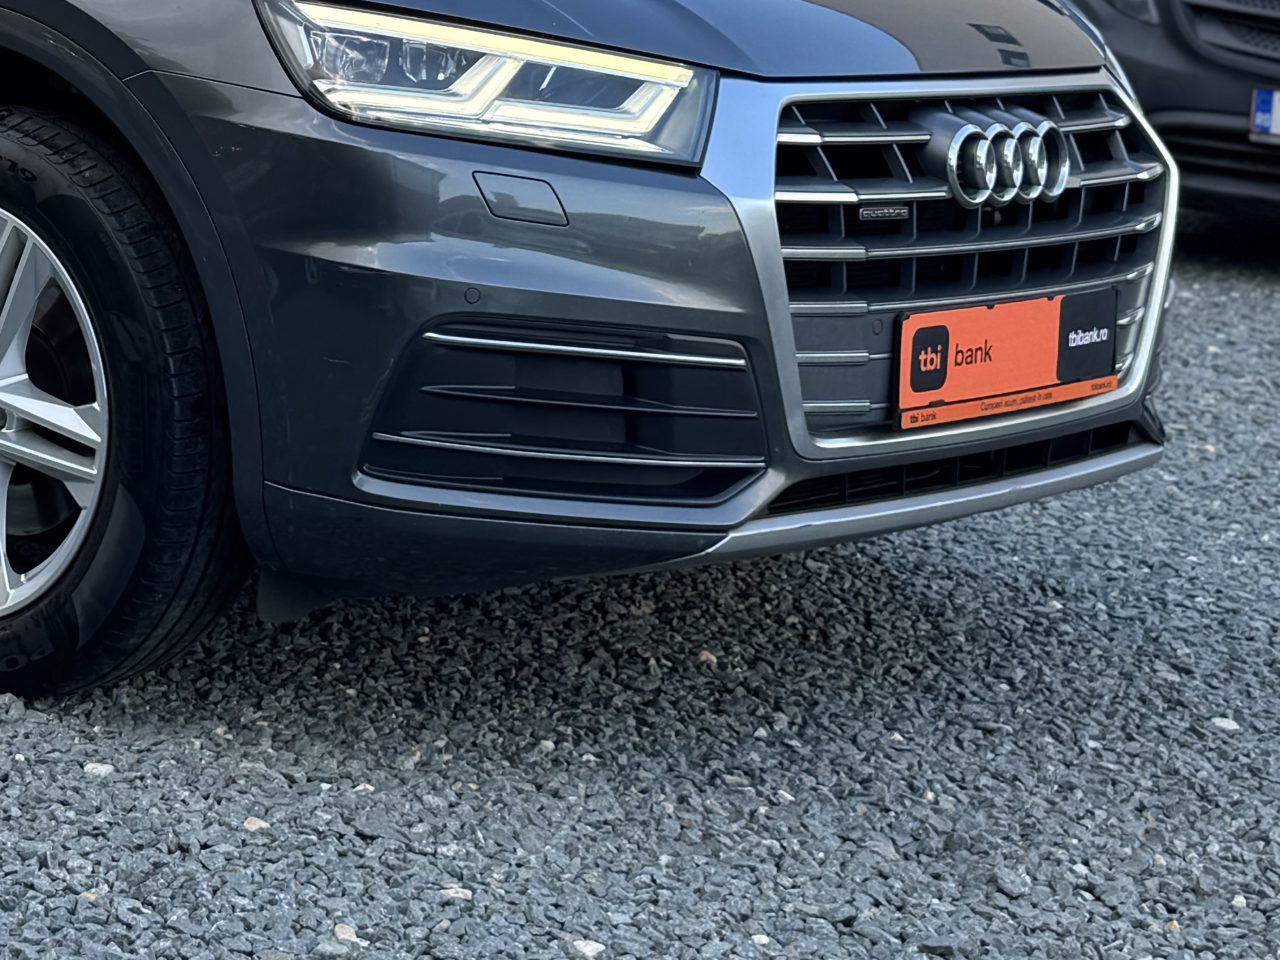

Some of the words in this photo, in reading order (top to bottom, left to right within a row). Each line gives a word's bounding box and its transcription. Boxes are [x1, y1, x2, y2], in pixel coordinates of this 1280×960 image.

[1068, 326, 1108, 347] tbibank.ro
[918, 344, 943, 372] tbi
[954, 338, 993, 368] bank
